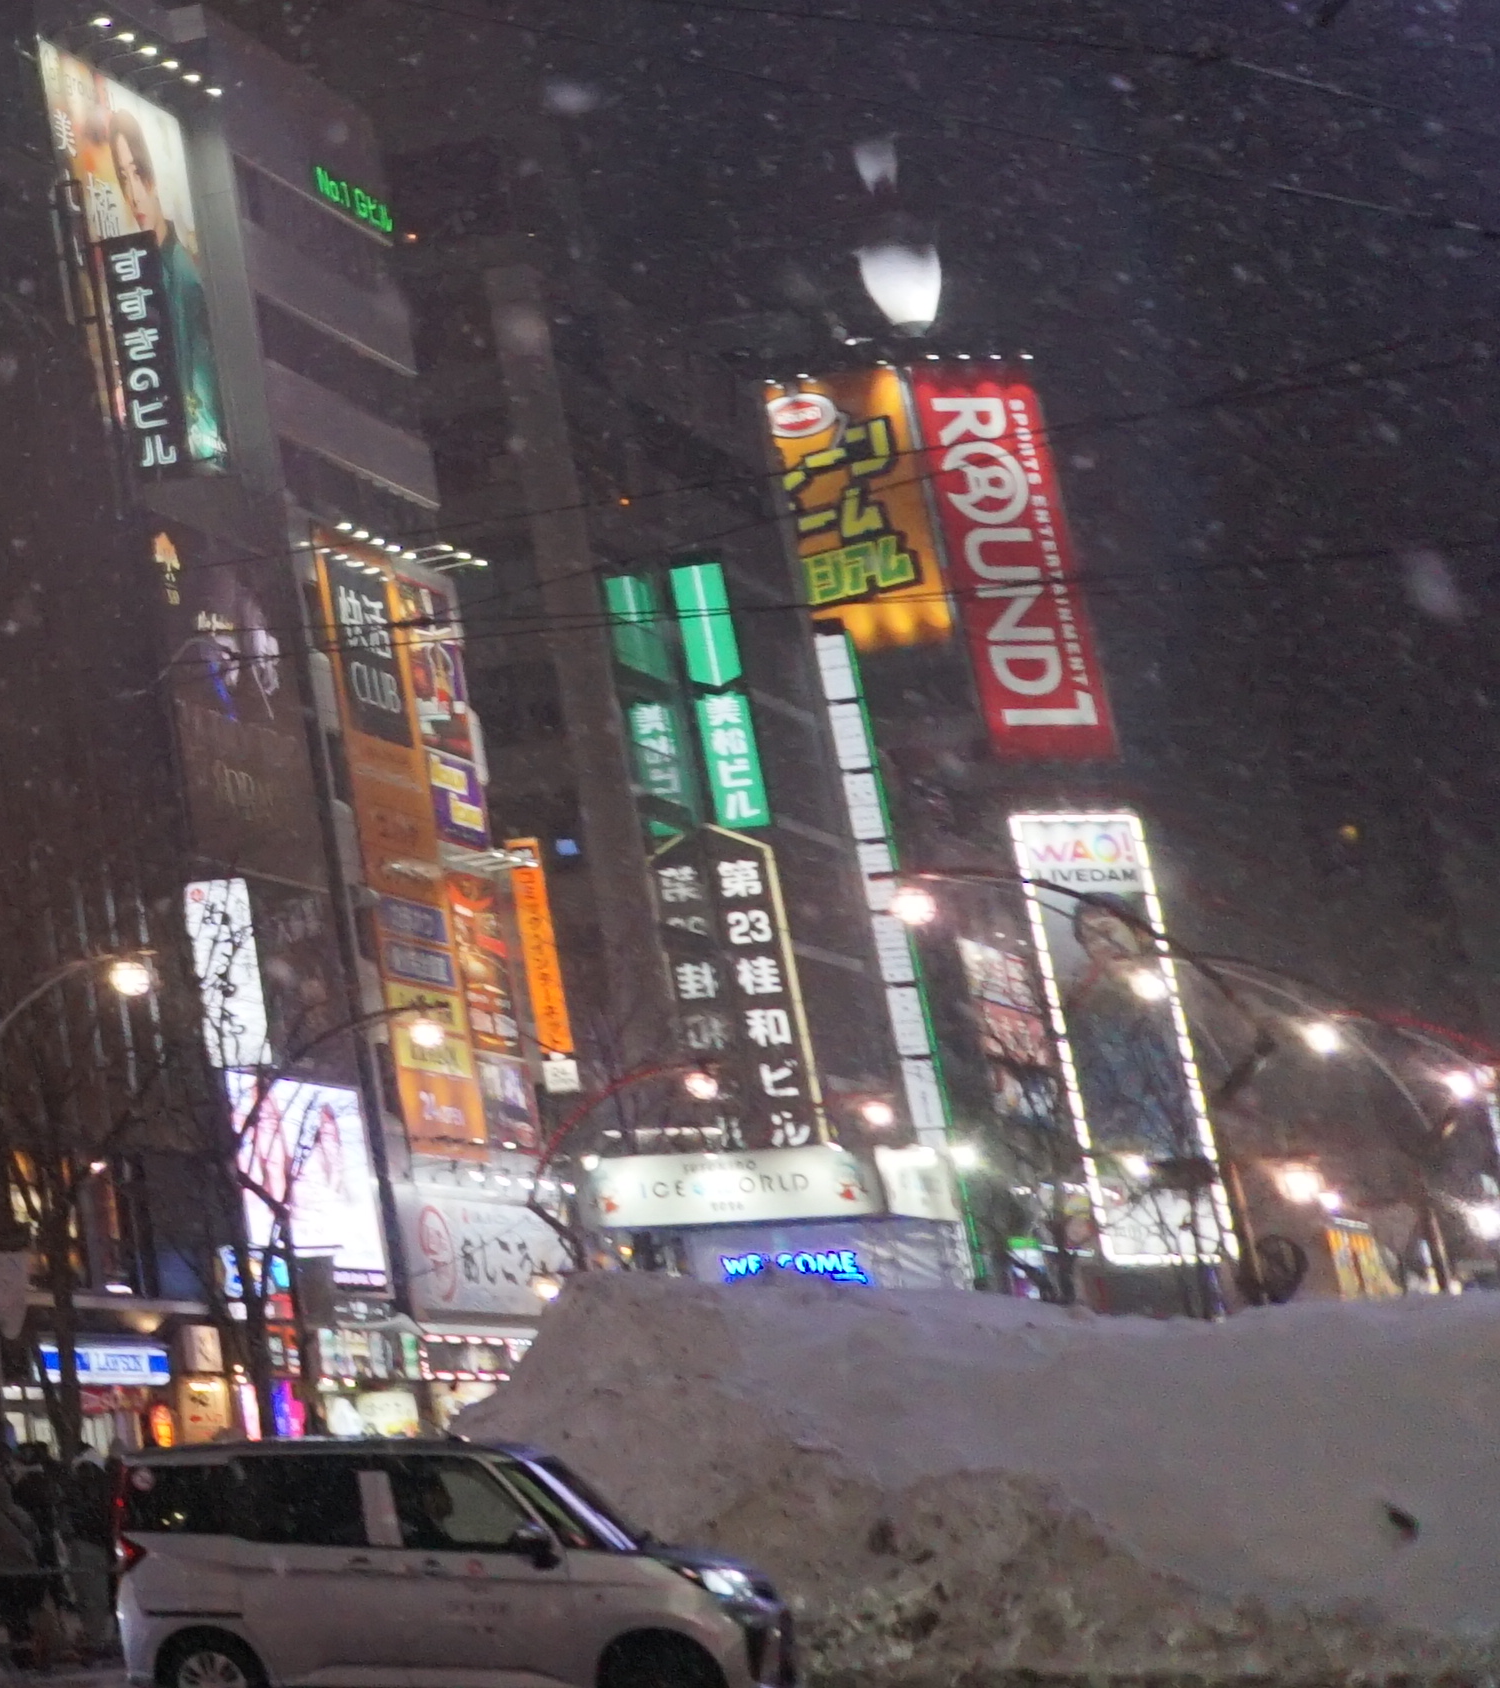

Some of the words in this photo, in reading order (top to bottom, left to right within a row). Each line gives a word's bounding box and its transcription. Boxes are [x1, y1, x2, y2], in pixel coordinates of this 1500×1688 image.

[110, 247, 177, 467] すすきのビル
[1008, 398, 1043, 485] SPORTS
[1033, 495, 1093, 693] ENTERTAINMENT
[1031, 833, 1134, 865] WAO!
[1038, 868, 1138, 885] LIVEDAM
[717, 859, 811, 1147] 第23桂和ビル
